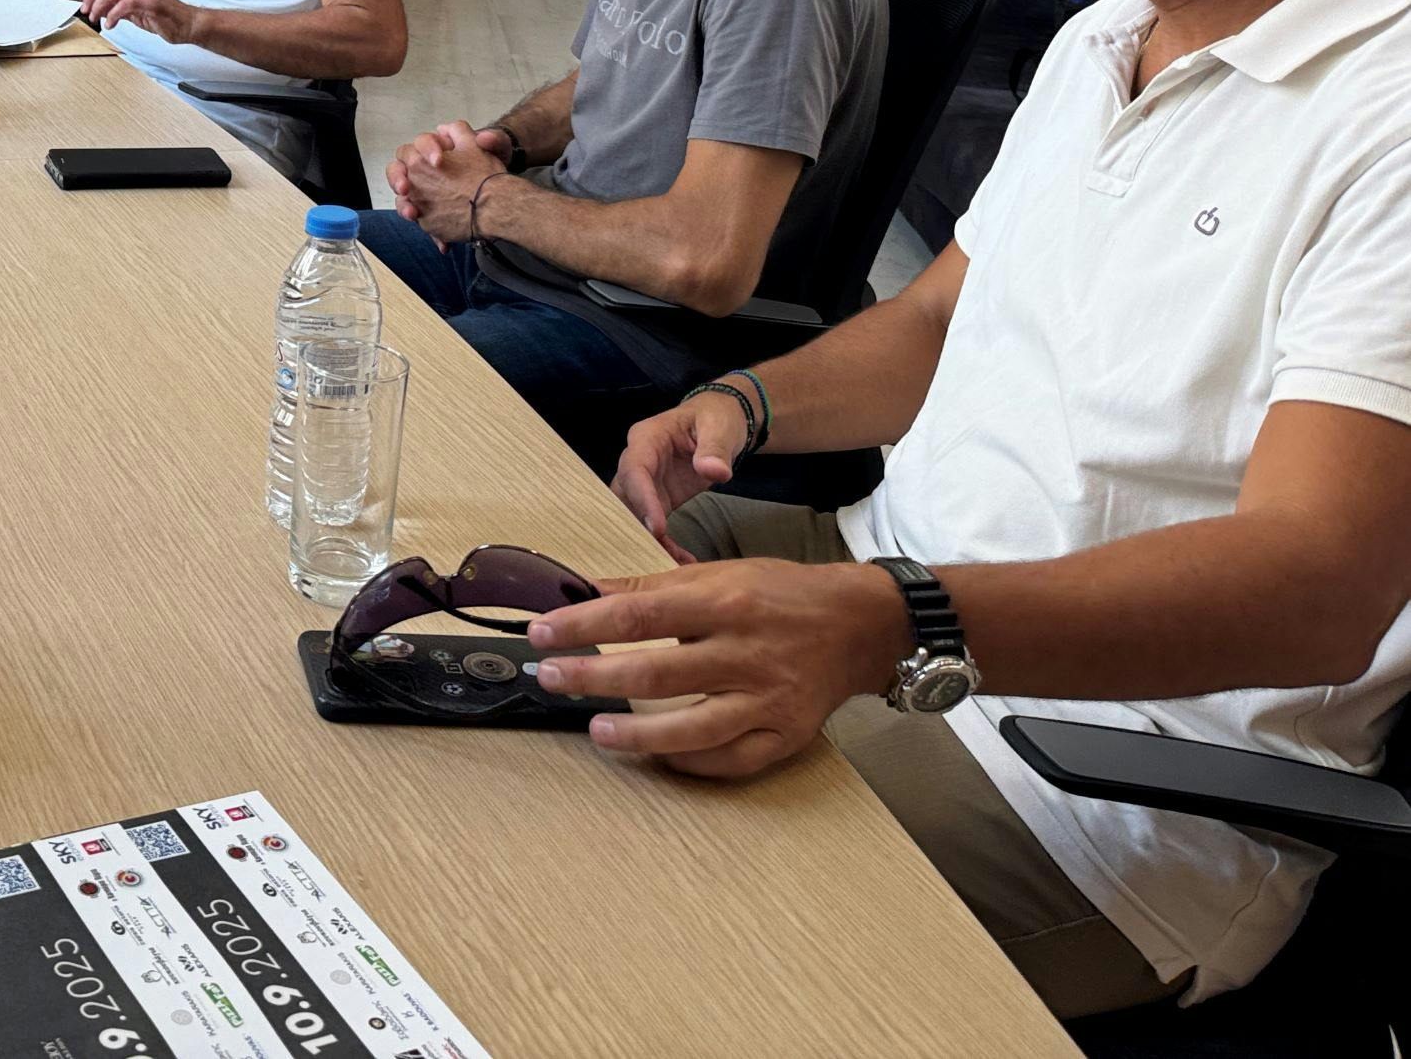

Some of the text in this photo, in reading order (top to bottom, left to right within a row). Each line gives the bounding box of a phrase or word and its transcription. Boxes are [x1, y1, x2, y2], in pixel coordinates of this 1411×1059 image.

[192, 807, 223, 831] SKY
[49, 841, 77, 865] SKY
[332, 907, 366, 941] ALEXAKIS
[181, 943, 213, 978] ALEXAKIS
